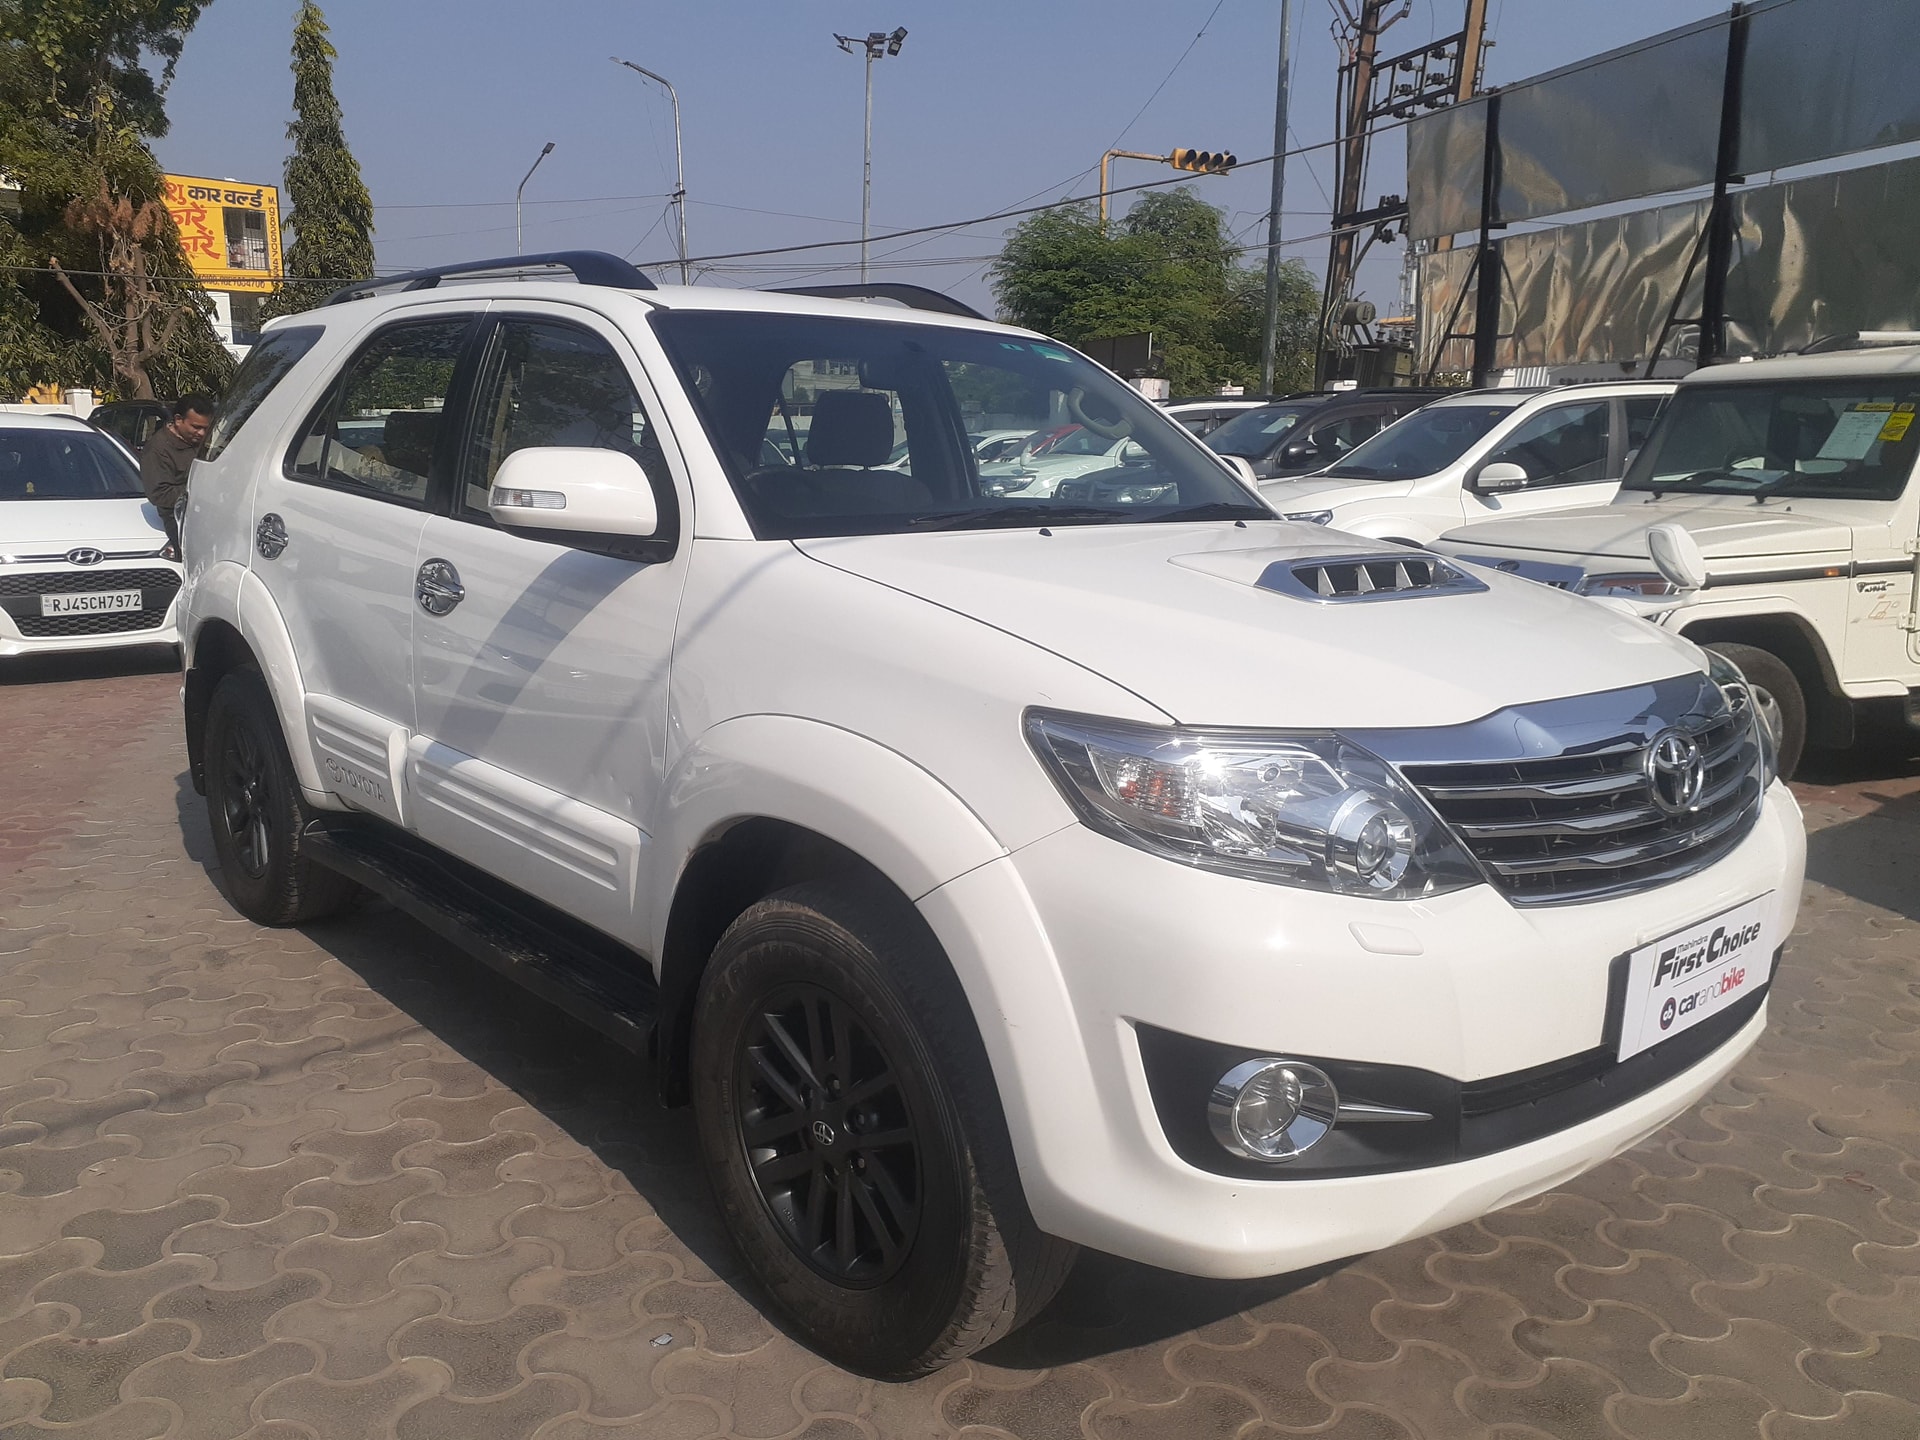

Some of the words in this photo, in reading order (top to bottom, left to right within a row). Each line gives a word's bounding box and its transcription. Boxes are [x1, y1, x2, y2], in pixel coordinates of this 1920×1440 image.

[165, 181, 187, 206] शु
[187, 185, 222, 203] कार
[53, 593, 141, 612] RJ45CH7972
[340, 767, 386, 802] TOYOTA
